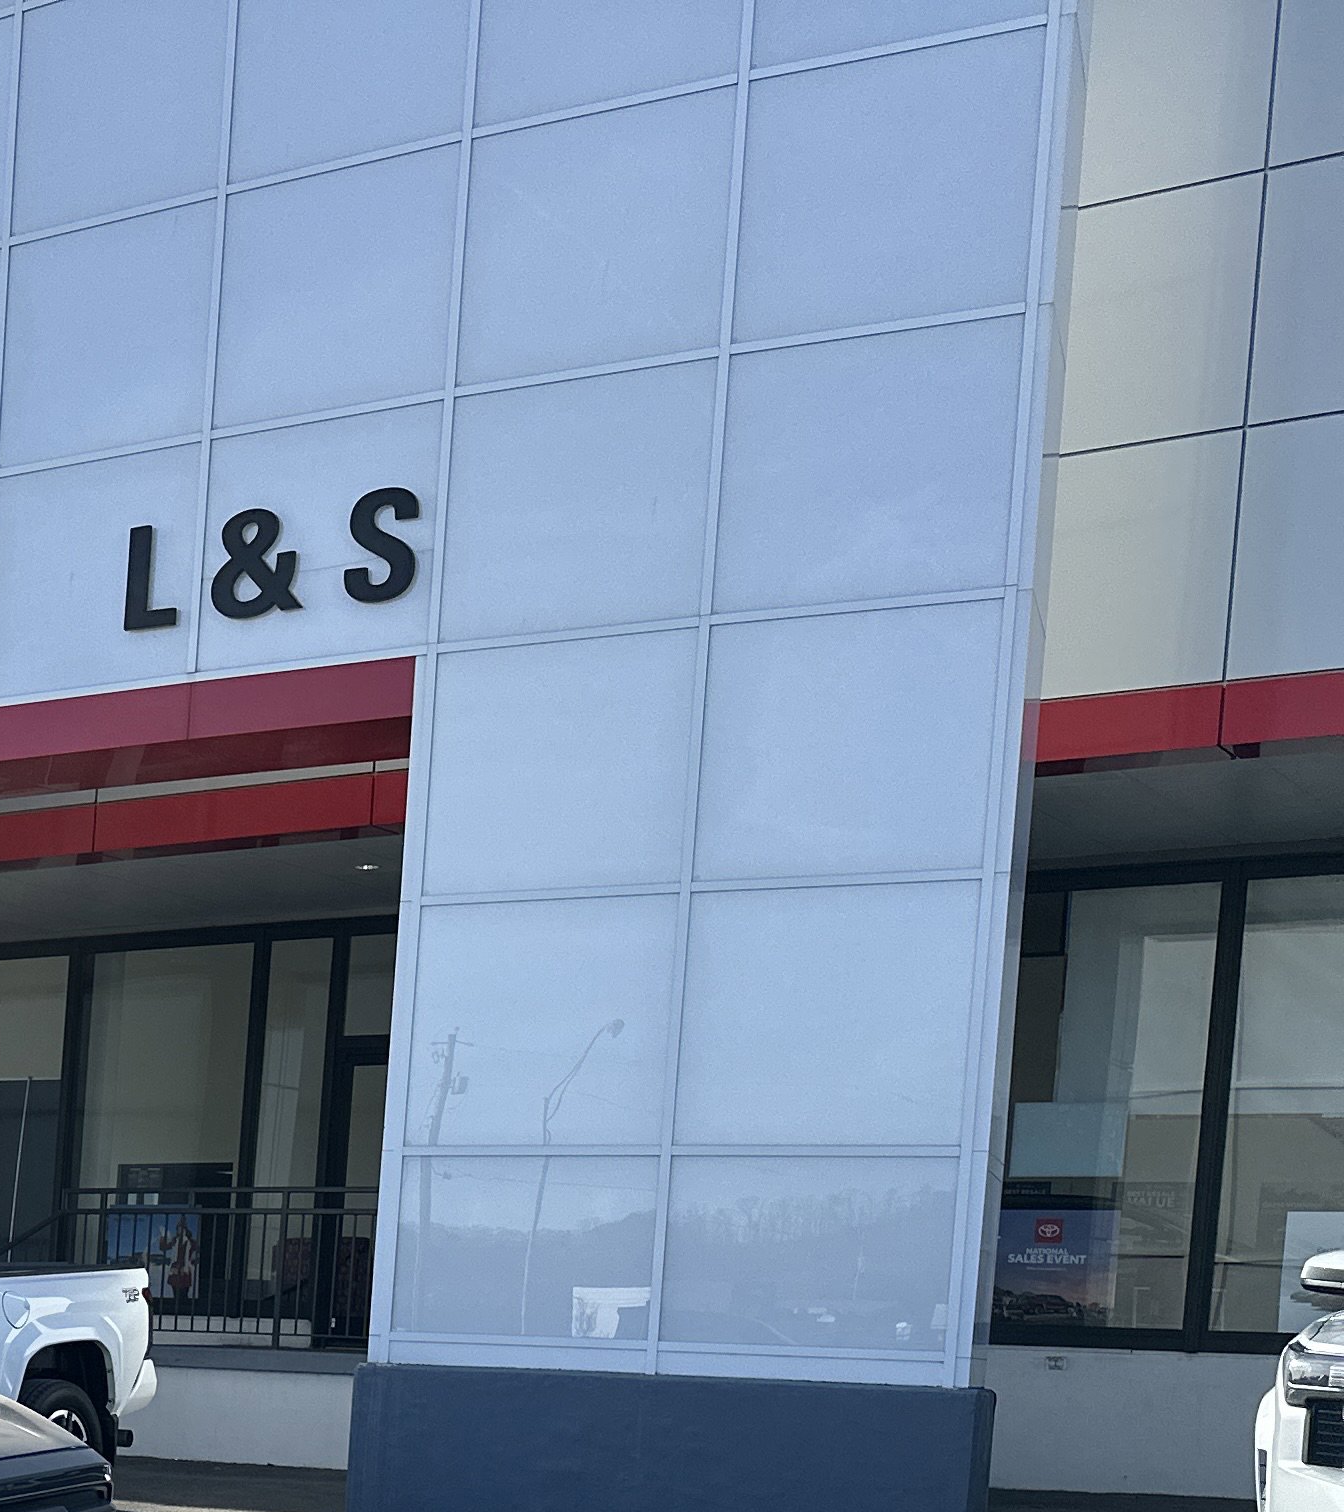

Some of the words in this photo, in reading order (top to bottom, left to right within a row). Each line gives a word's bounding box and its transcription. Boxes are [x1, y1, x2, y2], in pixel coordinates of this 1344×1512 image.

[124, 525, 177, 631] L
[211, 508, 304, 620] &
[343, 486, 420, 604] S
[1025, 1247, 1069, 1255] NATIONAL
[1007, 1253, 1044, 1264] SALES
[1046, 1254, 1087, 1265] EVENT
